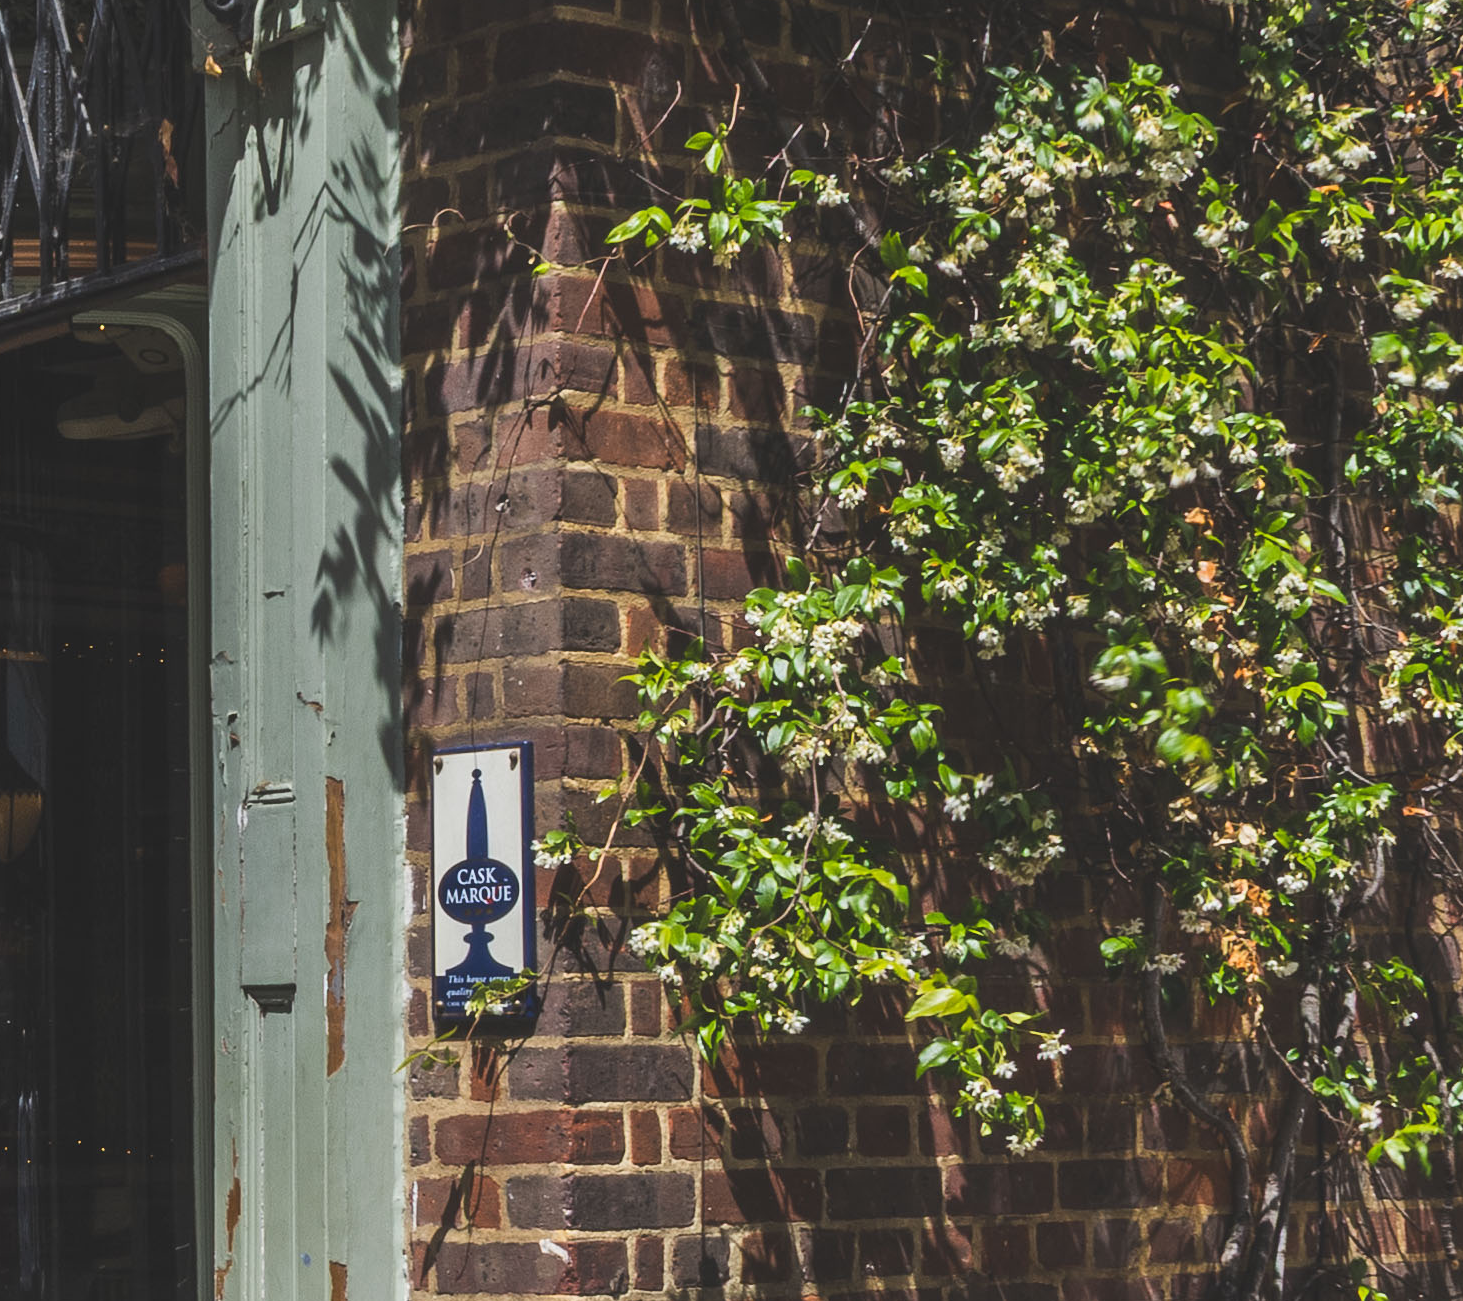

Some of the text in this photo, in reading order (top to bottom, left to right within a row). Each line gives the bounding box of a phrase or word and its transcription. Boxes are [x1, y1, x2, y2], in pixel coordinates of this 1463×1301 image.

[457, 867, 498, 886] CASK
[445, 885, 512, 905] MARQUE
[448, 974, 464, 984] This
